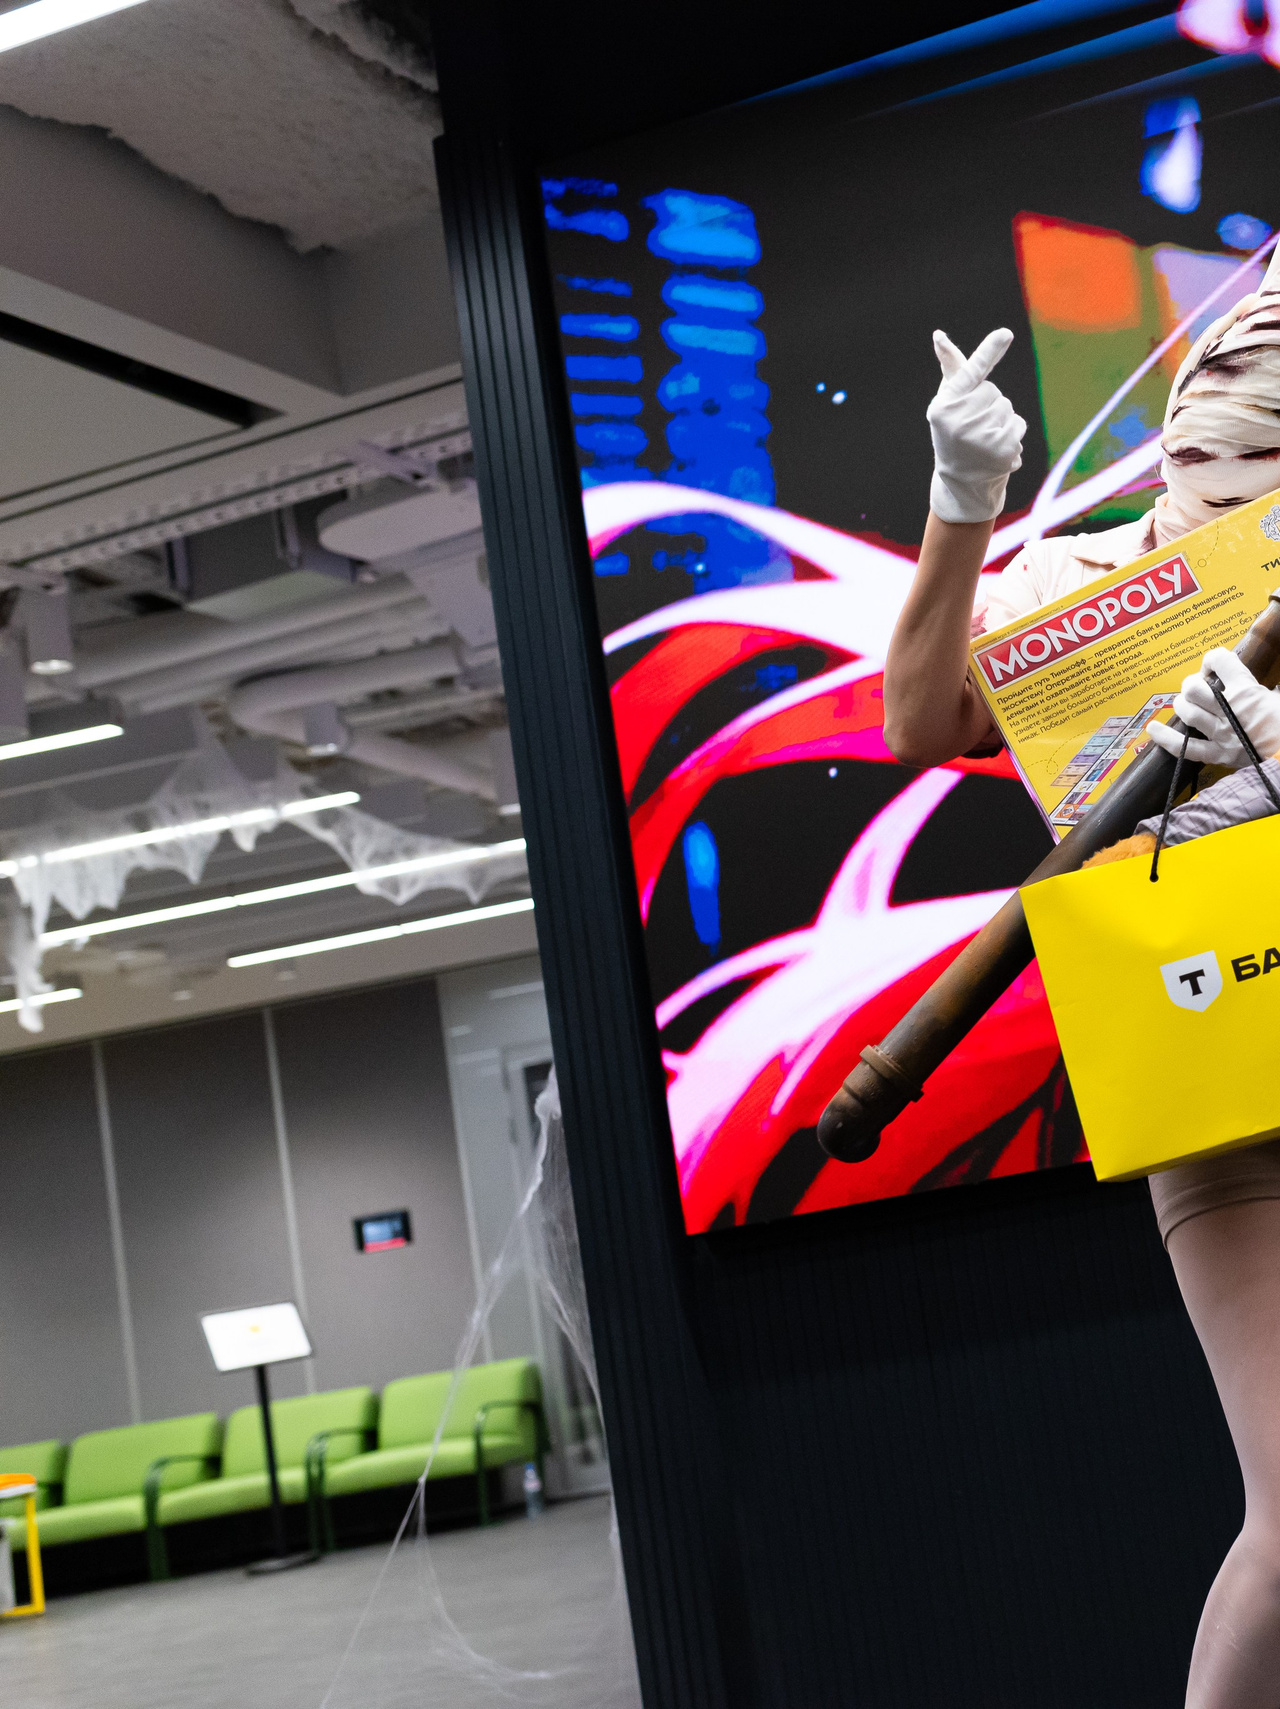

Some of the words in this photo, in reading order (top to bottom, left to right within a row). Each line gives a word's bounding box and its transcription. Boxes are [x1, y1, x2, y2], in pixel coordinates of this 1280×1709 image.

[987, 563, 1182, 682] MONOPOLY
[996, 684, 1034, 706] Пройдите
[1033, 677, 1051, 688] путь
[1049, 657, 1087, 679] Тинькофф
[1093, 634, 1136, 658] превратите
[1135, 625, 1155, 637] банк
[1160, 607, 1192, 626] мощную
[1191, 584, 1237, 610] финансовую
[1001, 688, 1045, 713] экосистему.
[1044, 665, 1092, 691] Опережайте
[1093, 652, 1118, 669] других
[1117, 638, 1151, 656] игроков,
[1150, 620, 1185, 640] грамотно
[1184, 591, 1244, 624] распоряжайтесь
[1008, 720, 1020, 728] На
[1020, 712, 1037, 723] пути
[1041, 701, 1059, 713] цели
[1058, 696, 1069, 704] вы
[1069, 675, 1113, 700] заработаете
[1112, 670, 1122, 678] на
[1121, 649, 1164, 674] инвестициях
[1169, 627, 1209, 650] банковских
[1013, 720, 1041, 737] узнаете
[1040, 707, 1067, 723] законы
[1066, 690, 1102, 710] большого
[1137, 665, 1153, 676] еще
[1152, 646, 1194, 668] столкнетесь
[1199, 626, 1233, 646] убытками
[1238, 616, 1253, 625] без
[1006, 701, 1039, 722] деньгами
[1045, 675, 1091, 701] охватывайте
[1090, 664, 1114, 679] новые
[1115, 650, 1144, 667] города.
[1039, 714, 1070, 733] Победит
[1071, 703, 1094, 718] самый
[1093, 681, 1138, 708] расчетливый
[1143, 650, 1203, 682] предприимчивый
[1209, 642, 1220, 650] он
[1219, 632, 1240, 645] такой
[1178, 968, 1206, 997] Т
